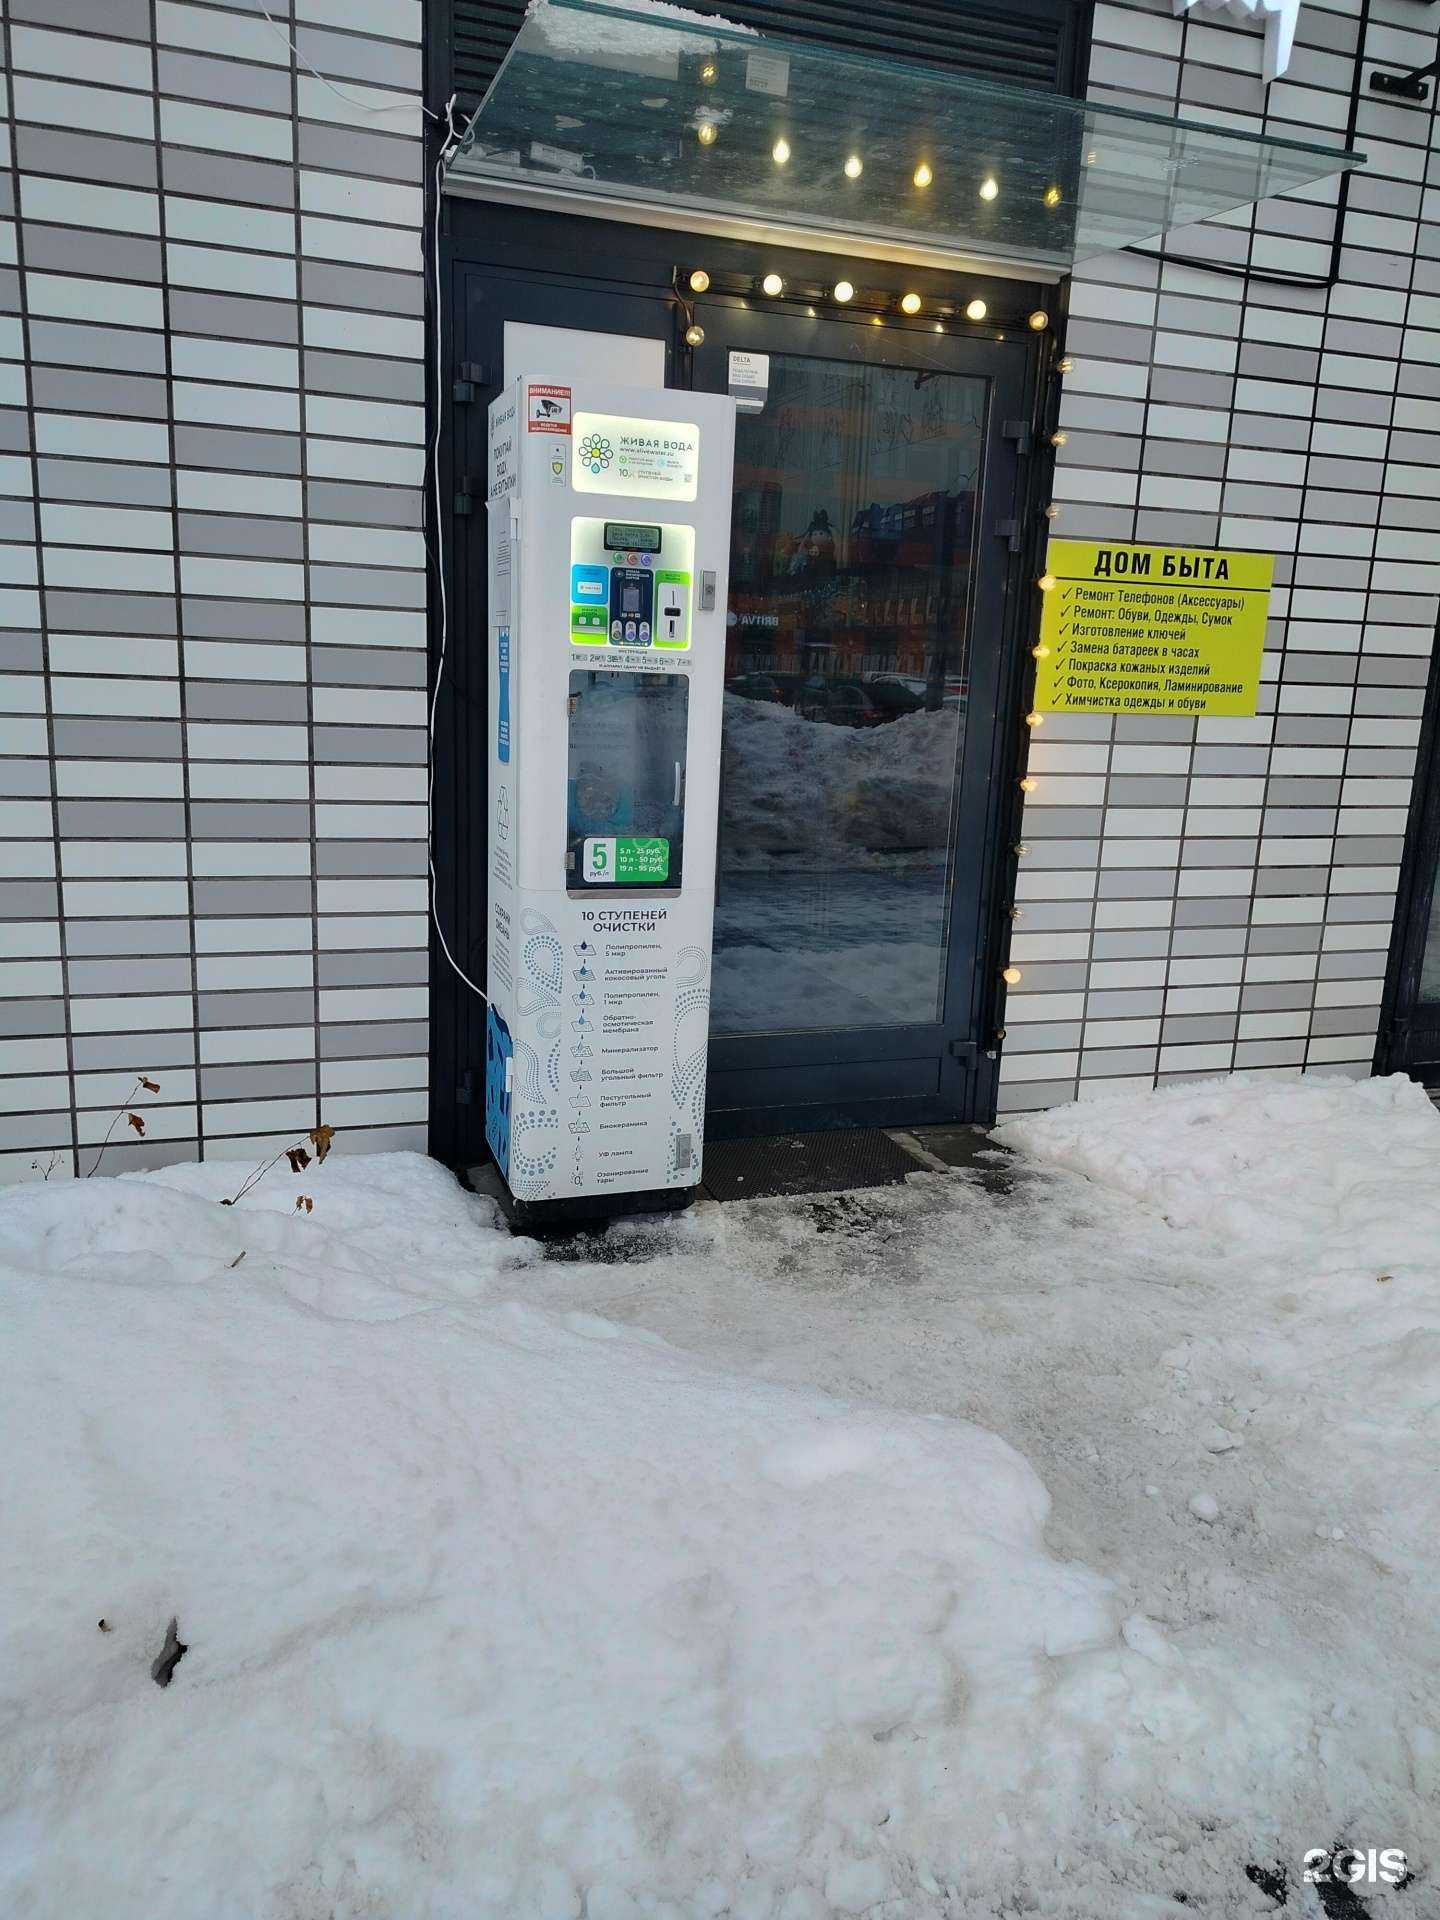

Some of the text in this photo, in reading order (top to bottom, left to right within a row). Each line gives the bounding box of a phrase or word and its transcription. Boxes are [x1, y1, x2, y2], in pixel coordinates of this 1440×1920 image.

[620, 436, 693, 451] ЖИВАЯ ВОДА
[1094, 550, 1230, 580] ДОМ БЫТА
[1075, 588, 1245, 611] Ремонт Телефонов (Аксессуары)
[1074, 606, 1233, 627] Ремонт: Обуви, Одежды, Сумок
[1071, 623, 1186, 640] Изготовление ключей
[1070, 641, 1200, 658] Замена батареек в часах
[1068, 659, 1210, 676] Покраска кожаных изделий
[1067, 677, 1243, 694] Фото, Ксерокопия, Ламинирование
[1065, 693, 1206, 710] Химчистка одежды и обуви
[592, 843, 607, 869] 5
[646, 848, 661, 856] руб.
[649, 856, 664, 864] руб.
[649, 865, 663, 873] руб.
[581, 908, 667, 920] 10 СТУПЕНЕЙ
[593, 922, 656, 932] ОЧИСТКИ
[605, 967, 668, 975] Активированный
[601, 1046, 659, 1054] Минерализатор
[601, 1072, 664, 1082] угольный фильтр
[600, 1121, 648, 1129] Биокерамика
[597, 1168, 649, 1178] Озонирование
